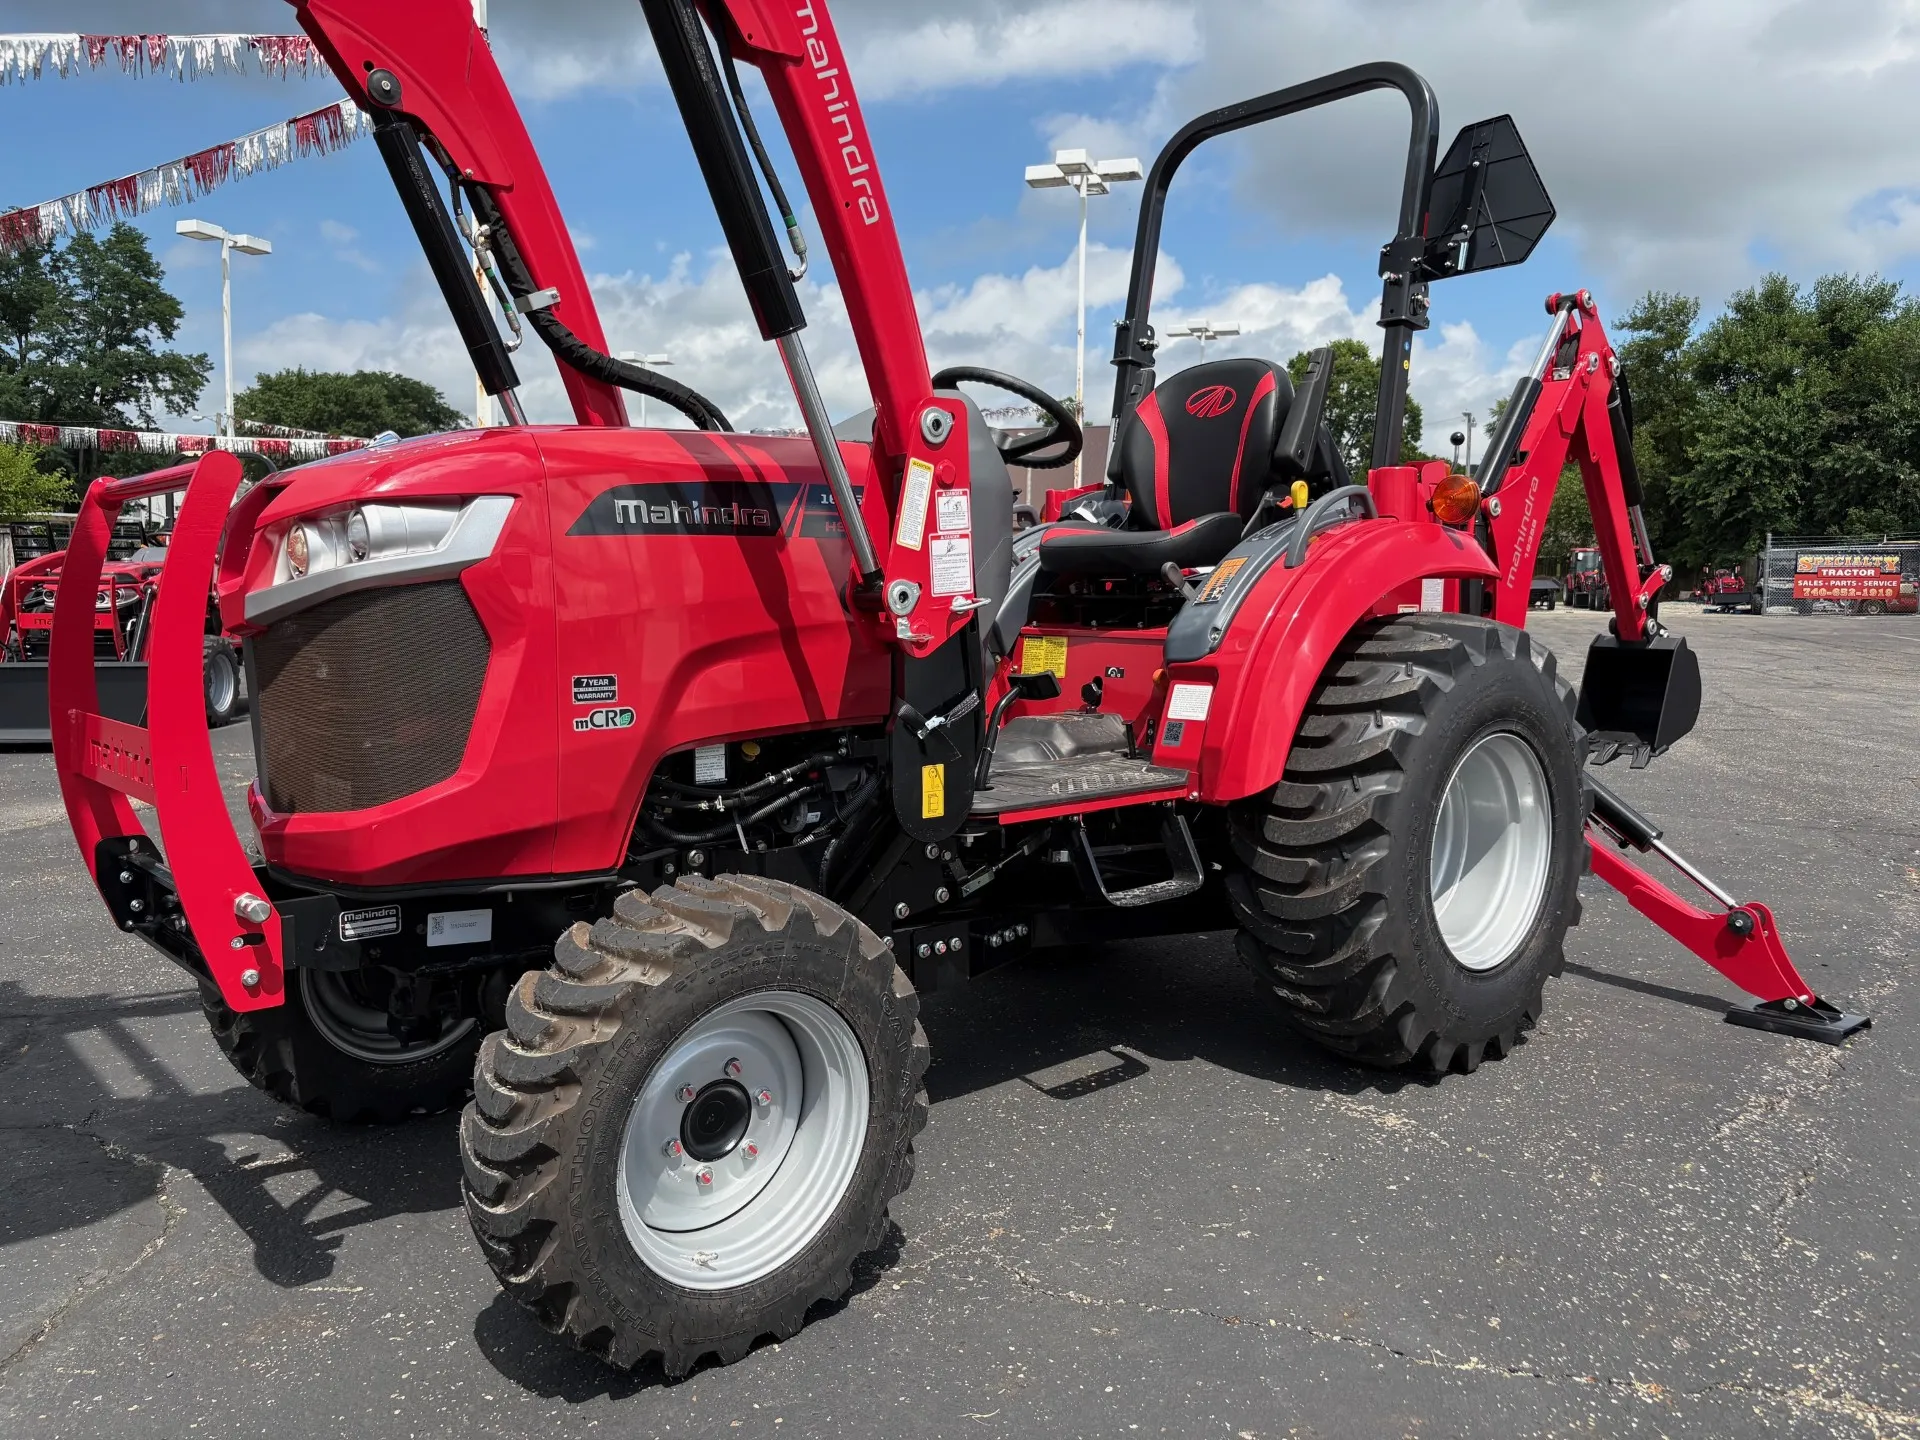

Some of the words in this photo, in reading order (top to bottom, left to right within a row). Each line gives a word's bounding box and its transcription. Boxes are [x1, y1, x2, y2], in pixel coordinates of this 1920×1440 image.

[614, 499, 771, 527] Mahindra
[1507, 476, 1539, 589] mahindra
[1798, 555, 1900, 571] SPECIALTY
[581, 679, 588, 687] 7
[577, 692, 613, 700] WARRANTY
[344, 908, 397, 922] Mahindra
